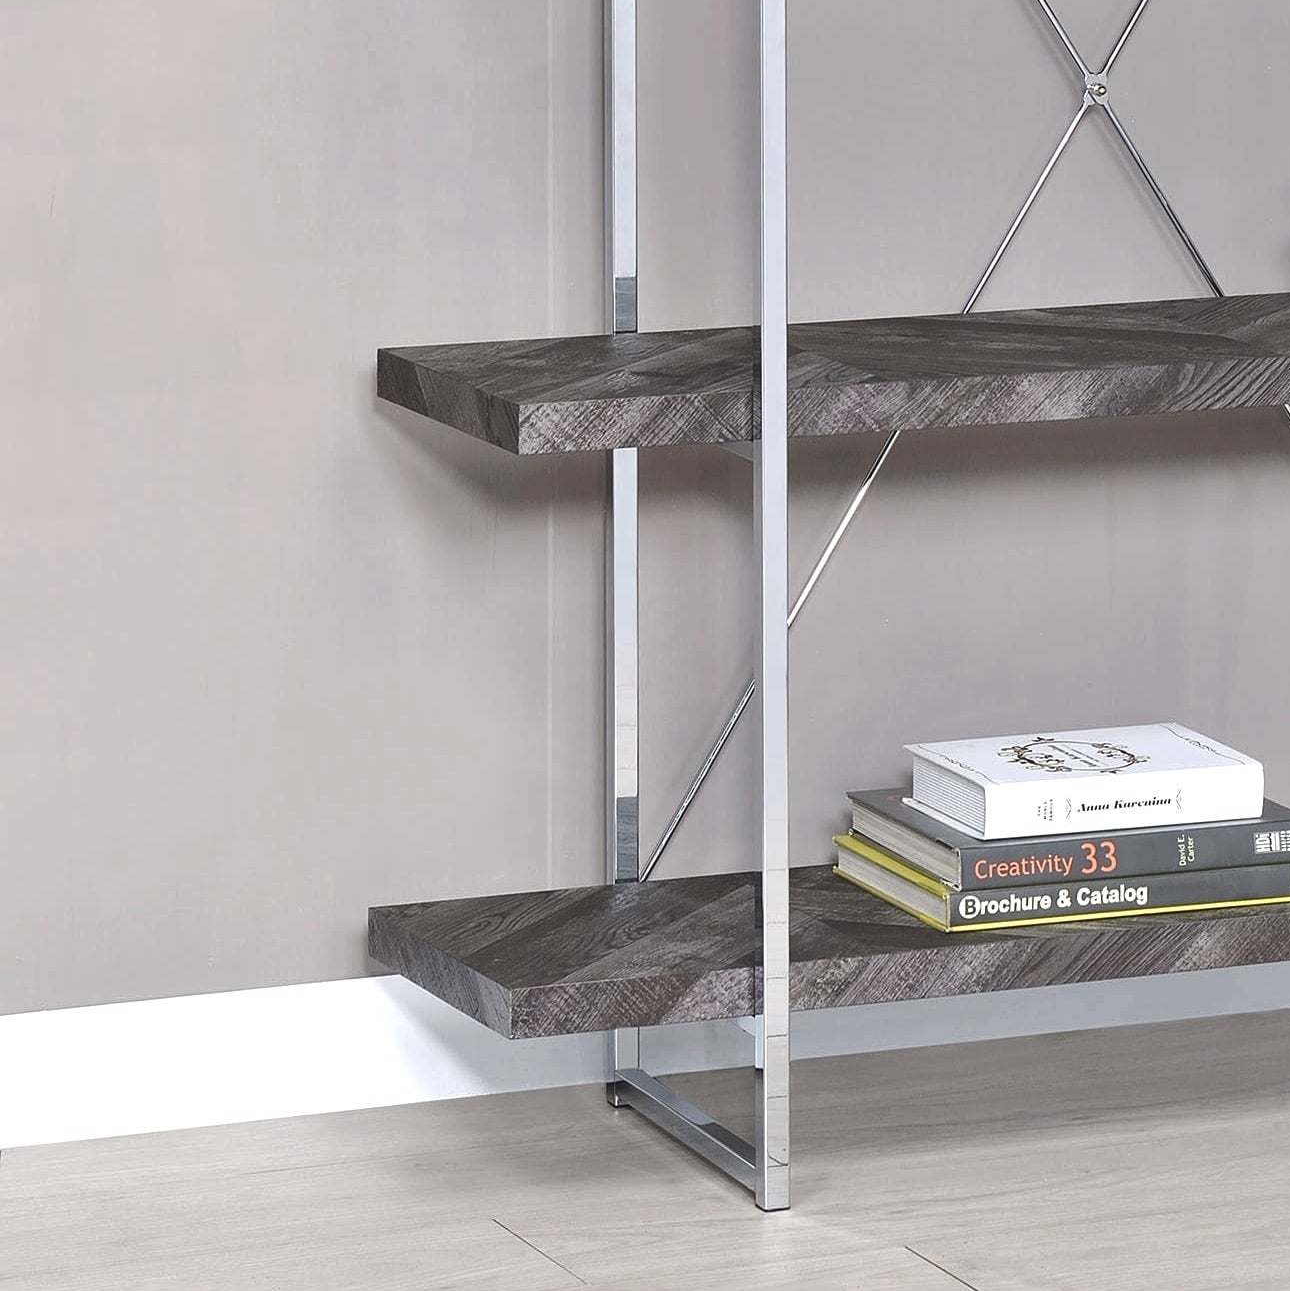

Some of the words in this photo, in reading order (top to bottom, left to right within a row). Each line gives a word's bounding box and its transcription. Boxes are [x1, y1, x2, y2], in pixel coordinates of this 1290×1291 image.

[974, 853, 1074, 880] Creativity
[1080, 840, 1118, 875] 33
[1177, 844, 1187, 866] David
[1187, 836, 1195, 862] Carter
[958, 892, 1052, 919] Brochure
[1057, 889, 1072, 908] &
[1076, 884, 1148, 905] Catalog
